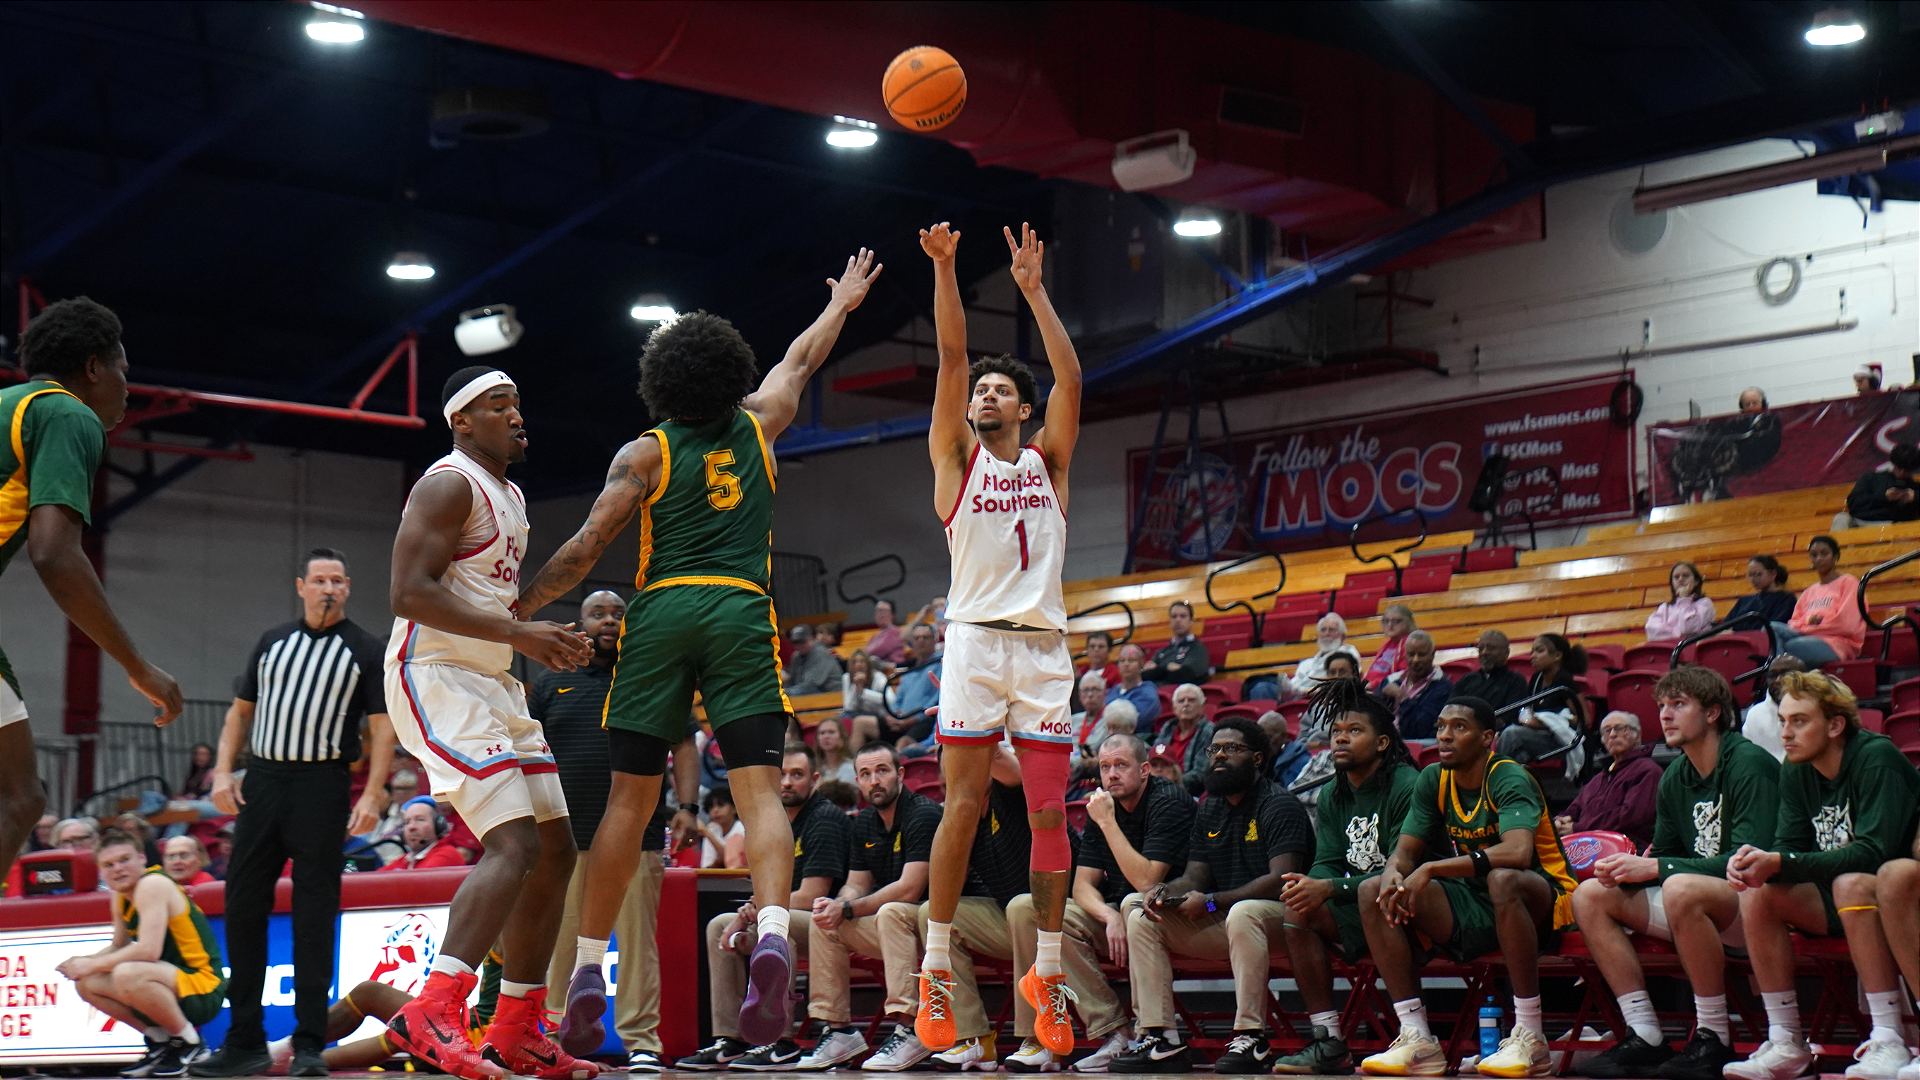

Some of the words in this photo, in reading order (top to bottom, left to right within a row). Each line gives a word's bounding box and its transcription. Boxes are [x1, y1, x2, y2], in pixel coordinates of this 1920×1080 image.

[1250, 434, 1332, 476] Follow
[1338, 423, 1381, 463] the
[703, 448, 744, 511] 5
[982, 469, 1043, 492] Florida
[1257, 440, 1463, 537] MOCS
[972, 494, 1053, 514] Southern
[1014, 519, 1029, 572] 1
[1040, 721, 1072, 735] MOCS
[0, 983, 58, 1008] ERN
[1, 1013, 33, 1037] GE
